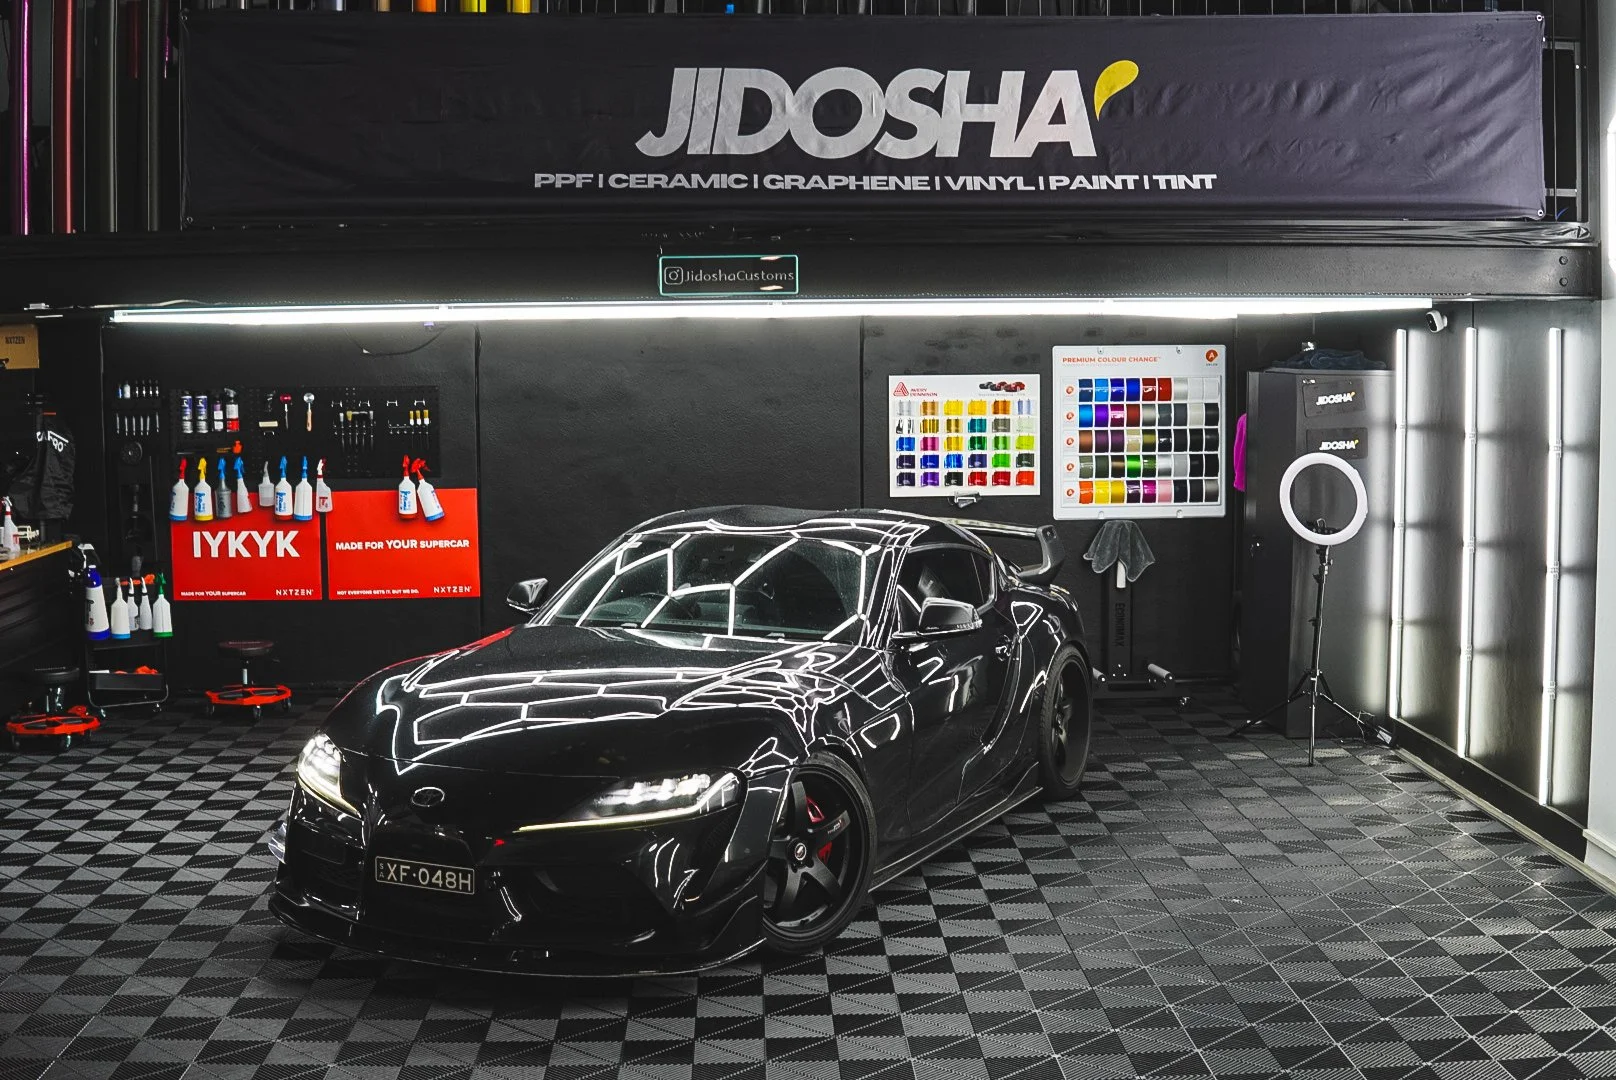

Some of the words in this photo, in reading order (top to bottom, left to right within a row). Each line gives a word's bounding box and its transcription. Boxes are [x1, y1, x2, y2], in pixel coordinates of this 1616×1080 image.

[635, 66, 1097, 159] JIDOSHA
[534, 173, 594, 188] PPF
[608, 173, 748, 189] CERAMIC
[763, 174, 931, 190] GRAPHENE
[944, 175, 1036, 190] VINYL
[1049, 175, 1140, 190] PAINT
[1153, 174, 1218, 190] TINT
[684, 269, 795, 282] JidoshaCustoms
[193, 530, 300, 558] IYKYK
[335, 542, 363, 550] MADE
[365, 541, 384, 549] FOR
[386, 539, 418, 549] YOUR
[419, 540, 470, 548] SUPERCAR
